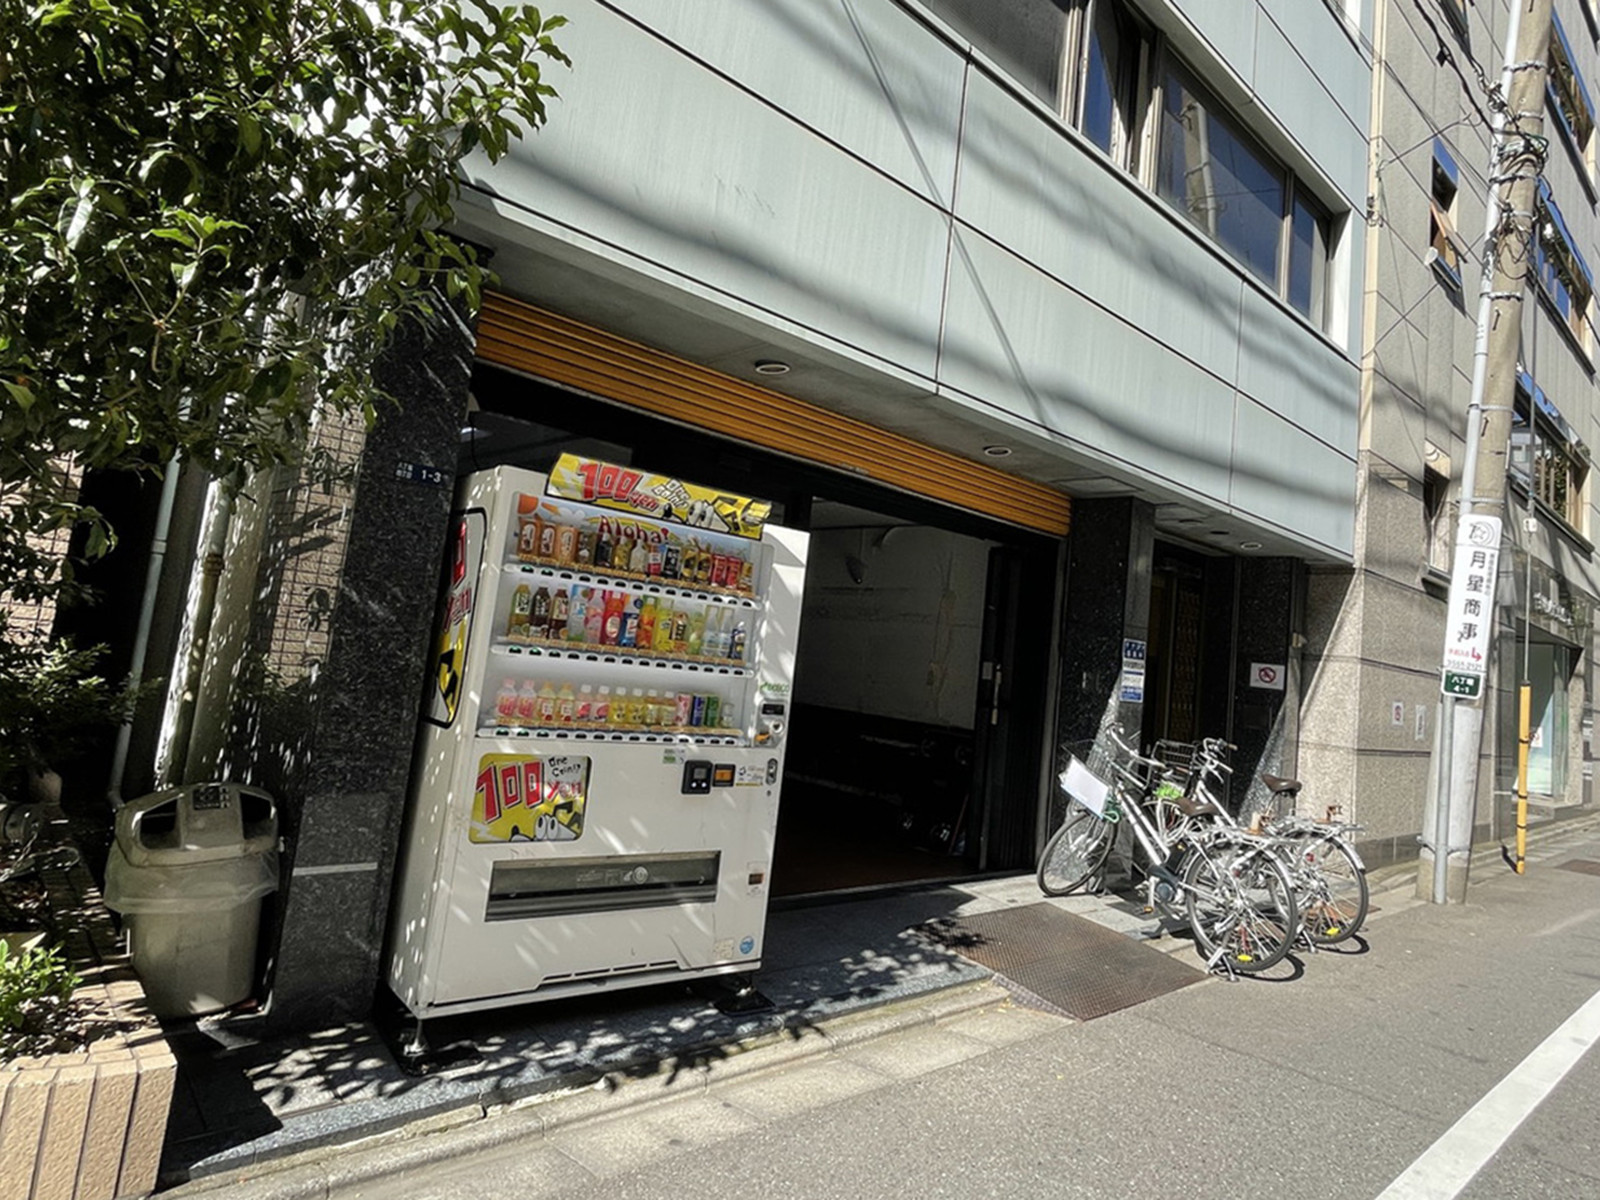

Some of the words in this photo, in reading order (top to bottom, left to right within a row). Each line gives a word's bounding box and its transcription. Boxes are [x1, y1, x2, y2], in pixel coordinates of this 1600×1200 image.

[422, 470, 441, 483] 1-3
[578, 463, 642, 500] 100
[1457, 550, 1486, 643] 月星商事
[476, 760, 543, 824] 100
